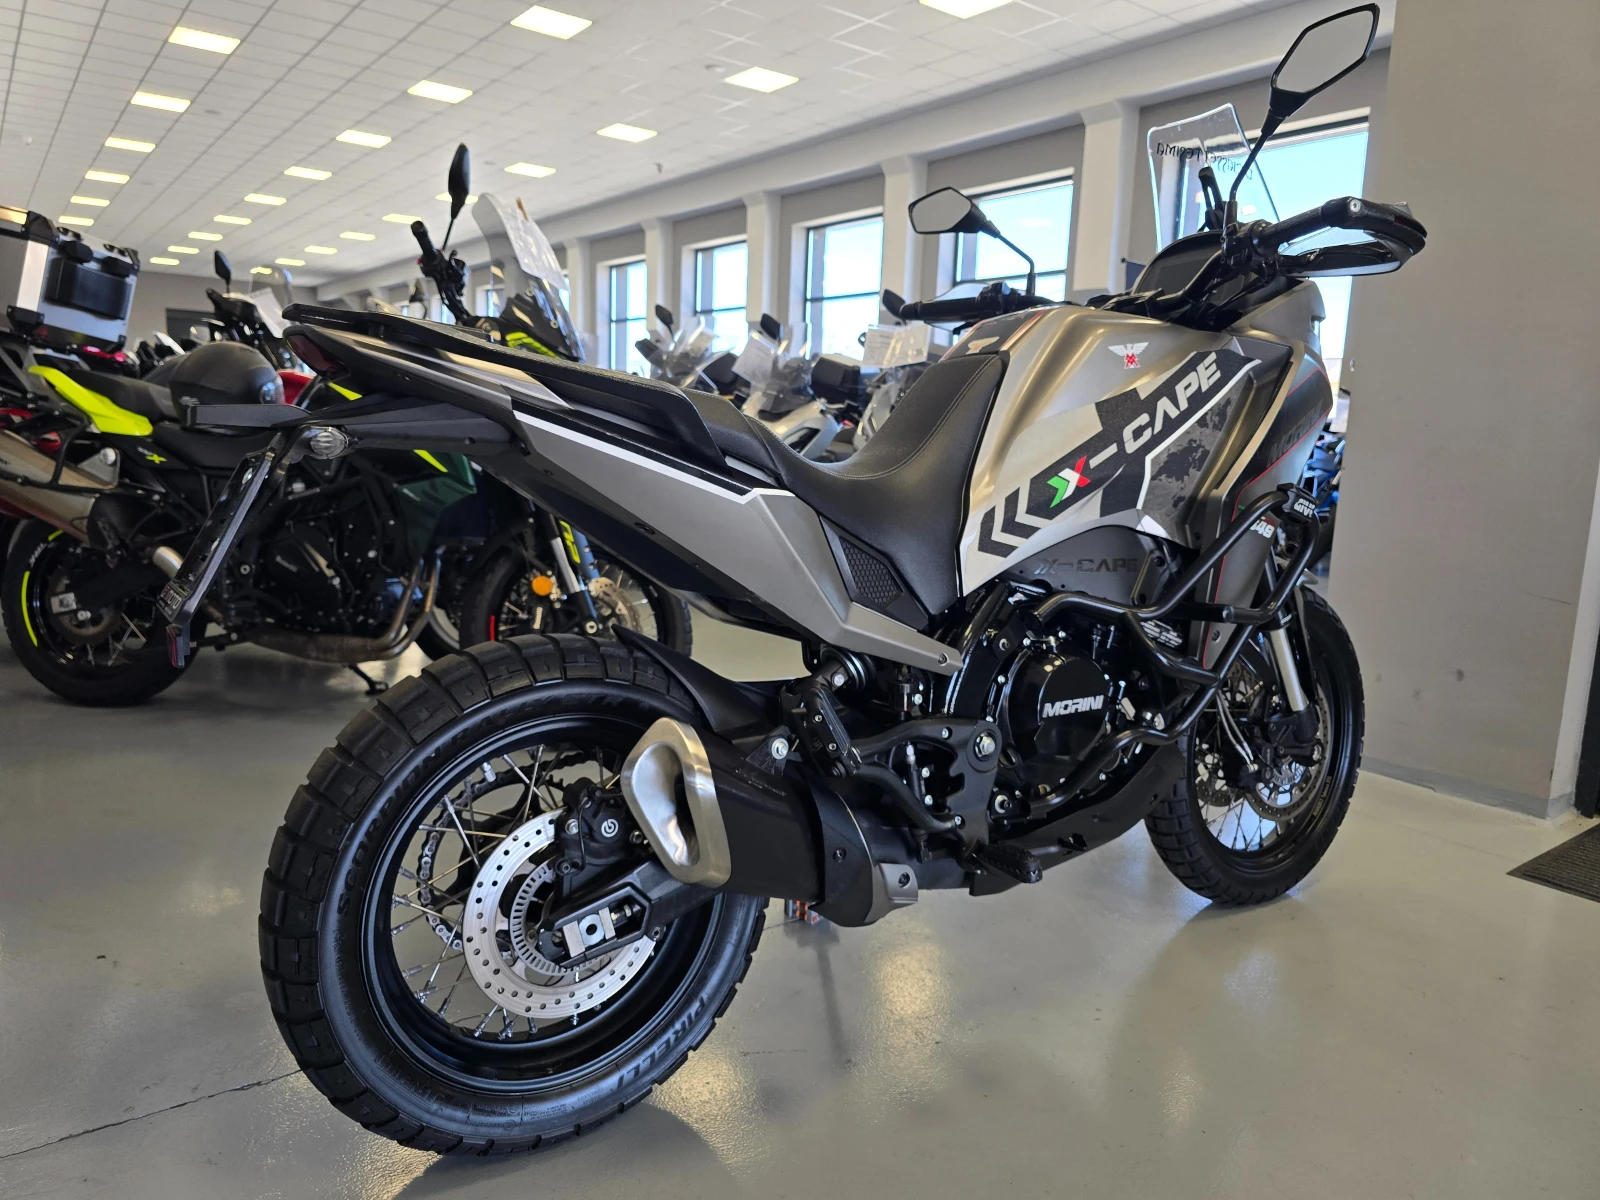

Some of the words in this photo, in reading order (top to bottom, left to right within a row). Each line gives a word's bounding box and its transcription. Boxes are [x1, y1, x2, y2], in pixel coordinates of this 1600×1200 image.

[1047, 352, 1221, 508] X-CAPE
[1034, 558, 1139, 575] X-CAPE
[1042, 695, 1104, 718] MORINI
[337, 746, 442, 918] SCORPION
[616, 994, 709, 1090] PIRELLI
